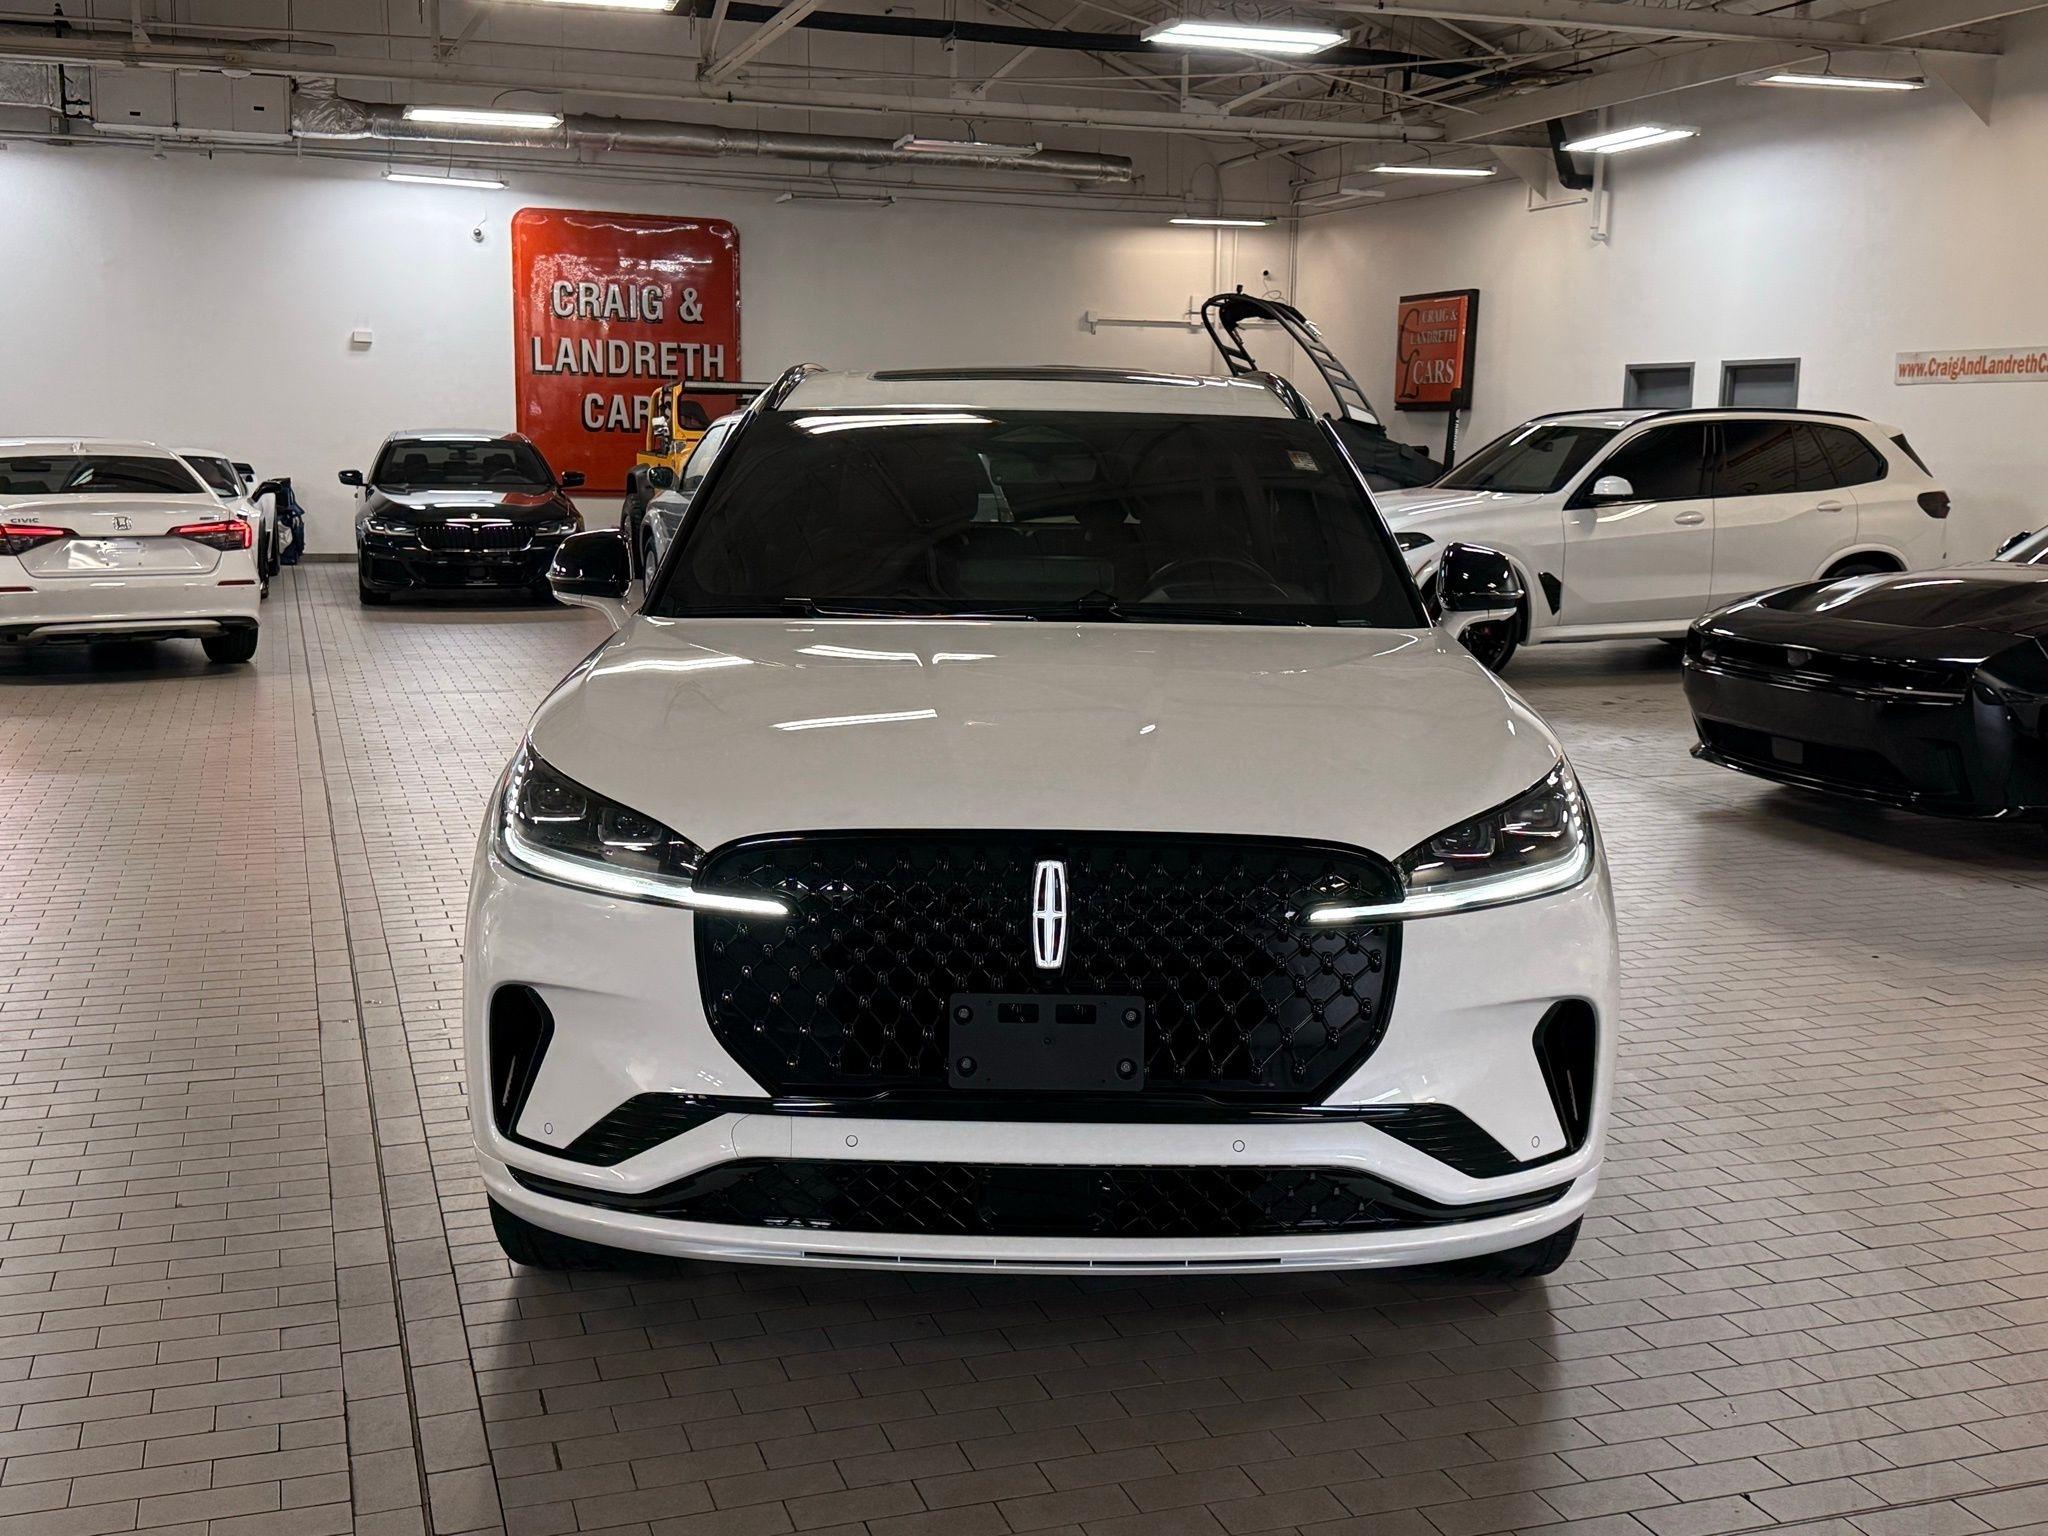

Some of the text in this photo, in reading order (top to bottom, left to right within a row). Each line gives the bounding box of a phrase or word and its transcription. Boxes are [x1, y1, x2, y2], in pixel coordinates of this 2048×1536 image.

[552, 280, 703, 322] CRAIG &
[1422, 309, 1448, 323] CRAIG
[1409, 328, 1457, 345] LANDRETH
[532, 336, 725, 379] LANDRETH
[1899, 352, 2048, 380] www.CraigAndLandrethC
[1413, 358, 1455, 385] CARS
